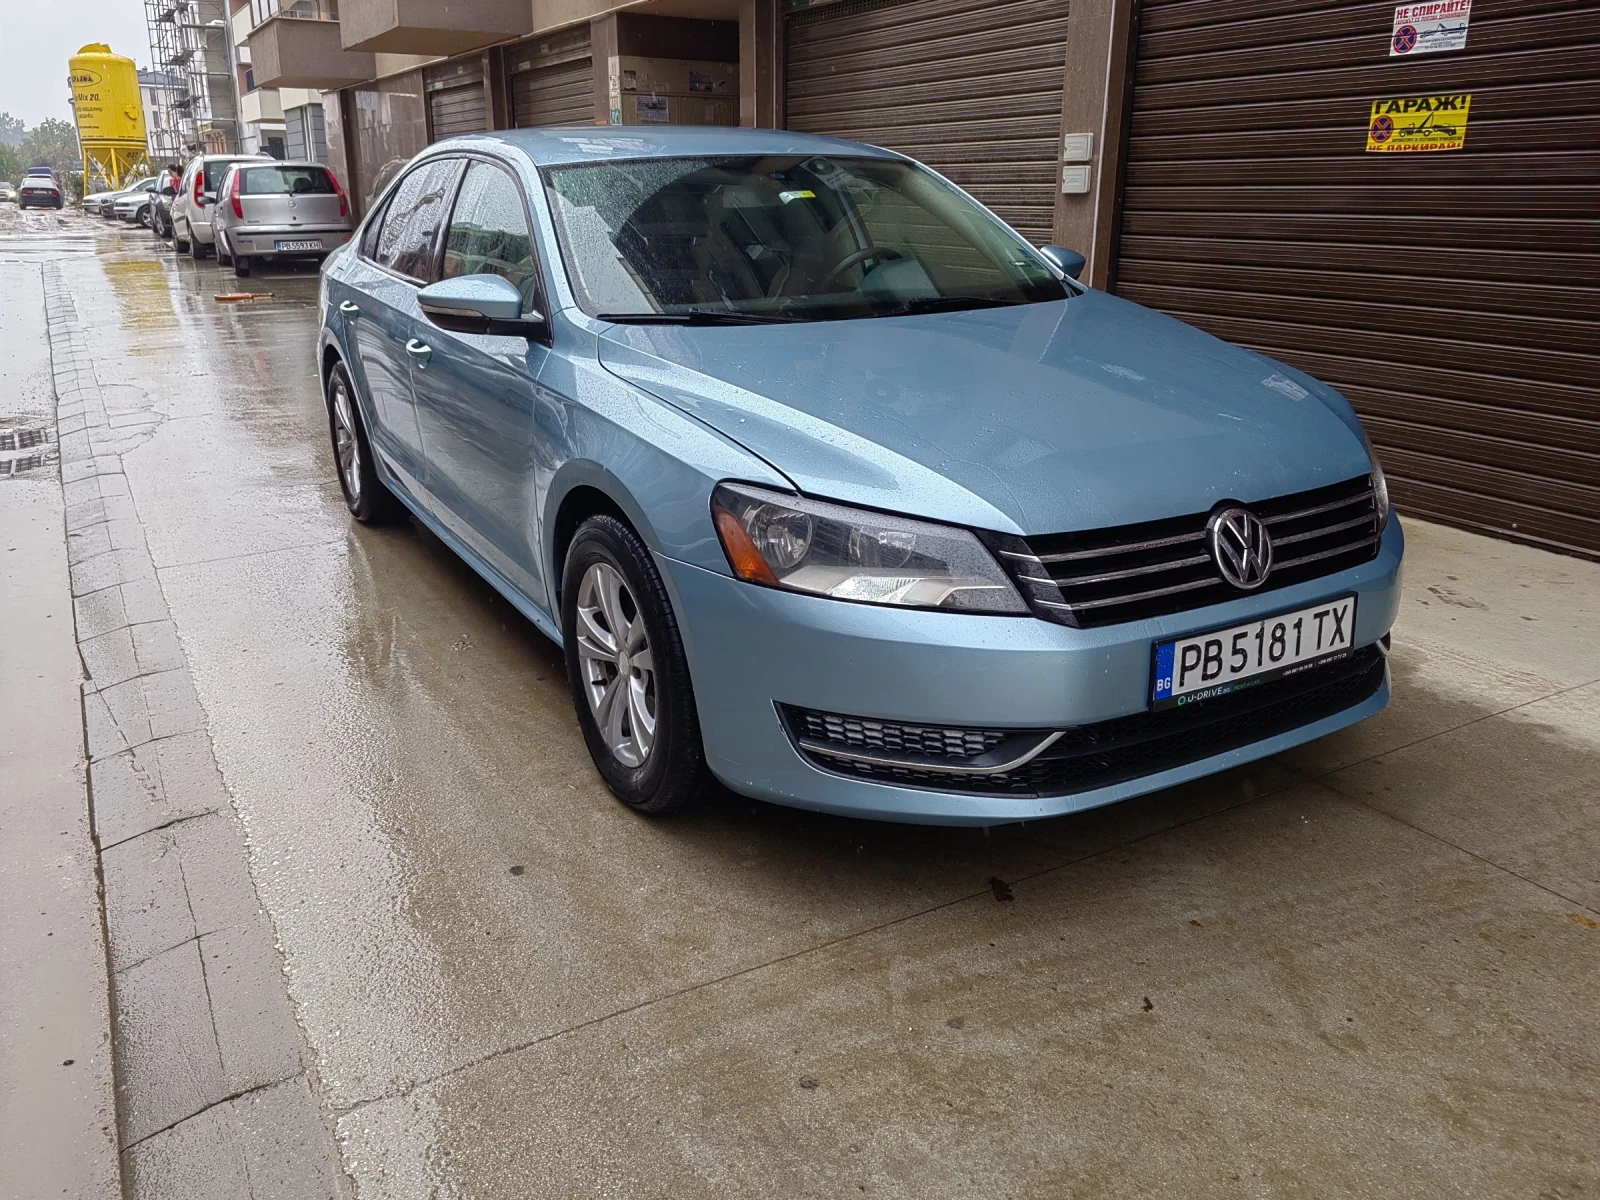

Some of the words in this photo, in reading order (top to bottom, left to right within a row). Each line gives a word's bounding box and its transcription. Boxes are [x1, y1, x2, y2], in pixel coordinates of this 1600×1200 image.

[1397, 8, 1409, 19] НЕ
[1375, 96, 1467, 114] ГАРАЖ!
[1178, 638, 1223, 688] PB
[1229, 617, 1303, 674] 5181
[1313, 604, 1349, 650] TX
[1156, 677, 1171, 692] BG
